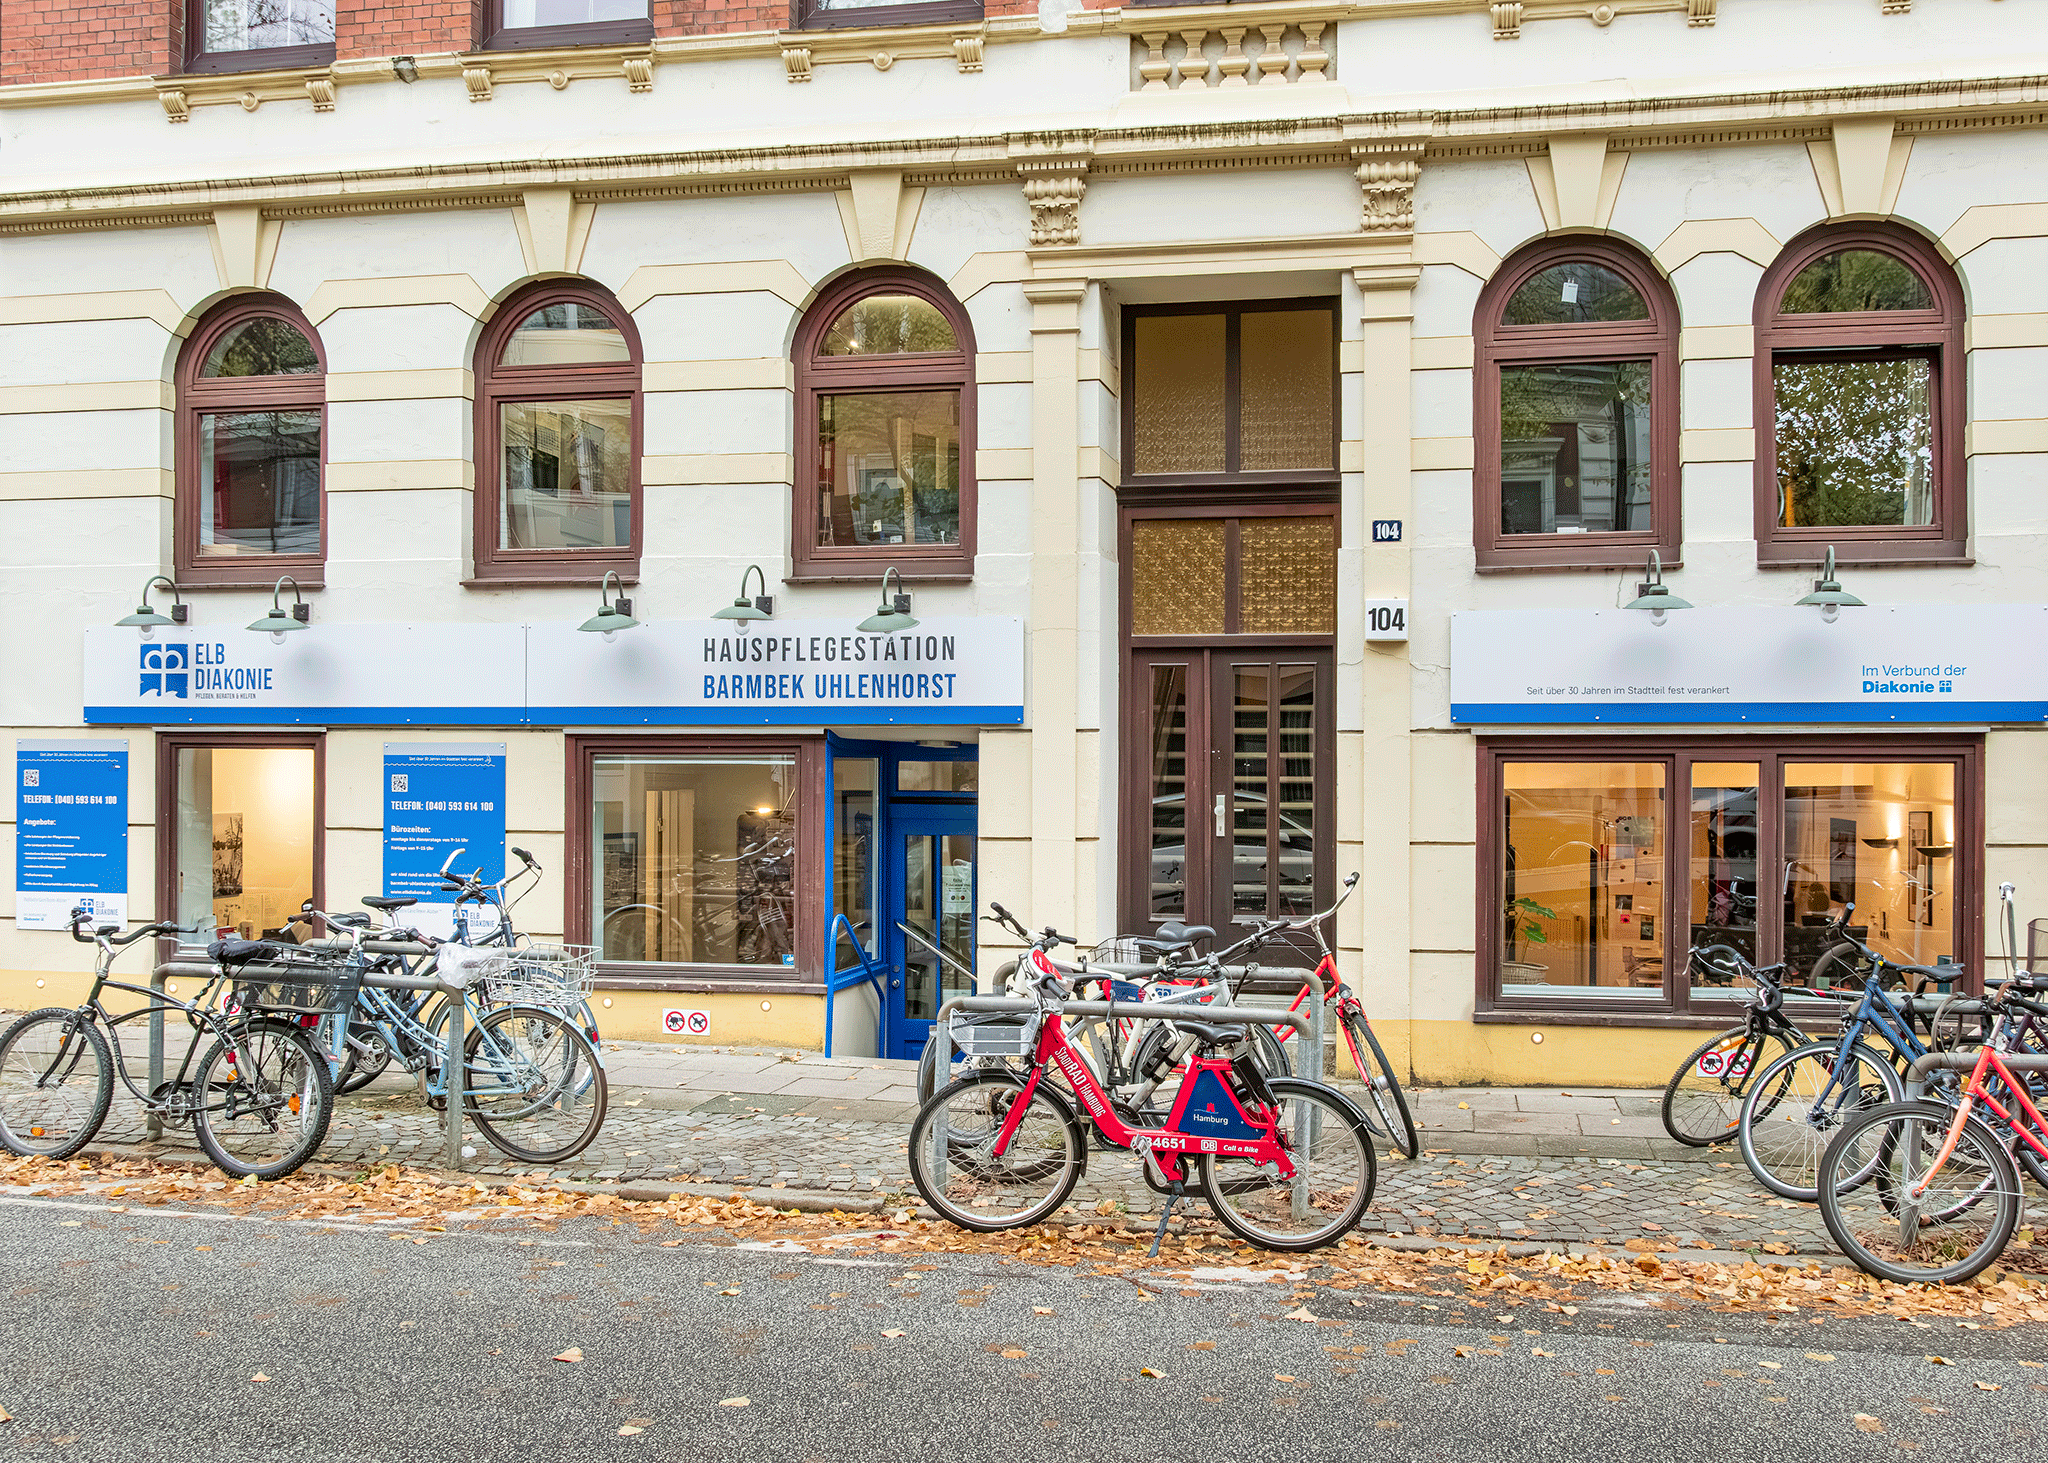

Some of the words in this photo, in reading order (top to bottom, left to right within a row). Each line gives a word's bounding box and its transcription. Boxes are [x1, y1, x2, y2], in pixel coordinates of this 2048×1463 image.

[1376, 522, 1399, 539] 104
[1368, 607, 1405, 631] 104
[195, 643, 225, 665] ELB
[704, 636, 955, 662] HAUSPFLEGESTATION
[1862, 665, 1879, 676] Im
[1882, 664, 1940, 677] Verbund
[1944, 664, 1967, 676] der
[195, 668, 273, 690] DIAKONIE
[703, 674, 805, 699] BARMBEK
[815, 673, 957, 698] UHLENHORST
[1526, 686, 1544, 695] Seit
[1546, 686, 1565, 695] über
[1568, 686, 1579, 695] 30
[1581, 686, 1611, 695] Jahren
[1614, 686, 1625, 695] im
[1627, 686, 1665, 695] Stadtteil
[1668, 686, 1685, 695] fest
[1687, 686, 1730, 695] verankert
[1862, 680, 1935, 693] Diakonie
[23, 795, 54, 804] TELEFON:
[55, 795, 74, 805] (040)
[75, 795, 89, 805] 593
[90, 795, 103, 805] 614
[105, 796, 117, 805] 100
[391, 801, 424, 811] TELEFON:
[425, 801, 446, 811] (040)
[448, 801, 462, 811] 593
[464, 801, 478, 811] 614
[480, 802, 494, 811] 100
[23, 818, 56, 827] Angebote:
[391, 825, 431, 833] Bürozeiten:
[470, 920, 495, 928] DIAKONIE
[1079, 1082, 1107, 1118] HAMBURG
[1193, 1114, 1229, 1125] Hamburg
[1203, 1141, 1215, 1150] DB
[1223, 1144, 1237, 1152] Call
[1244, 1145, 1259, 1153] Bike
